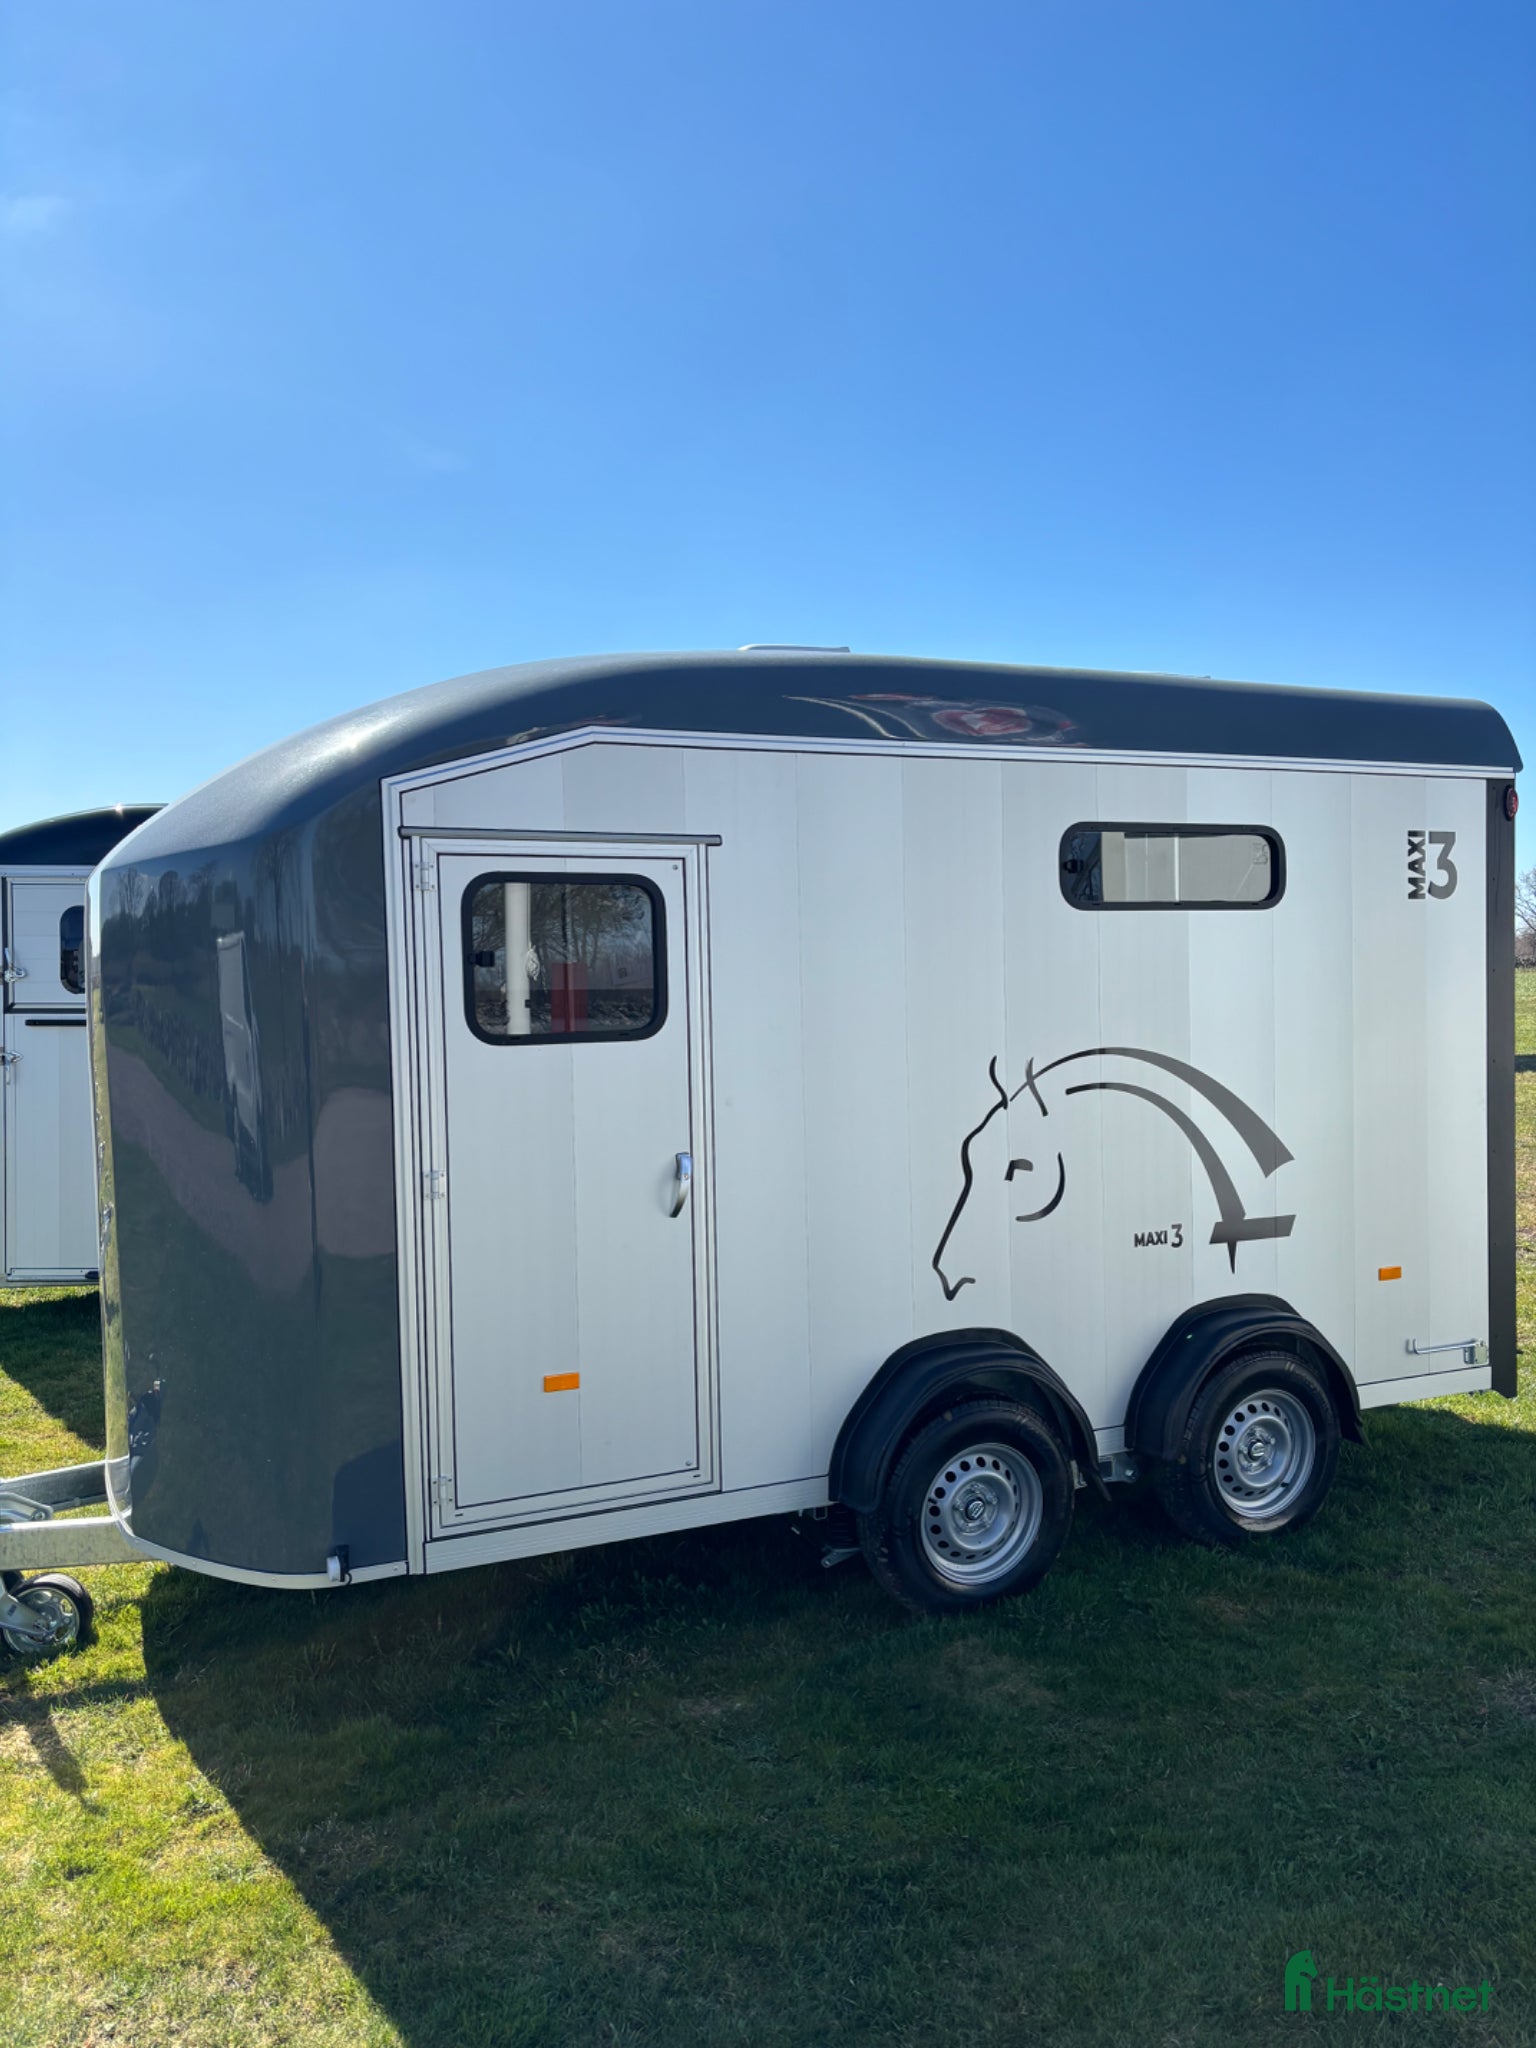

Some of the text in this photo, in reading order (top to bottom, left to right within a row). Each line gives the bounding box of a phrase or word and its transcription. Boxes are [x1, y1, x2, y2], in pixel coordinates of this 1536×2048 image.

[1408, 830, 1458, 900] MAXI 3
[1134, 1223, 1184, 1248] MAXI 3
